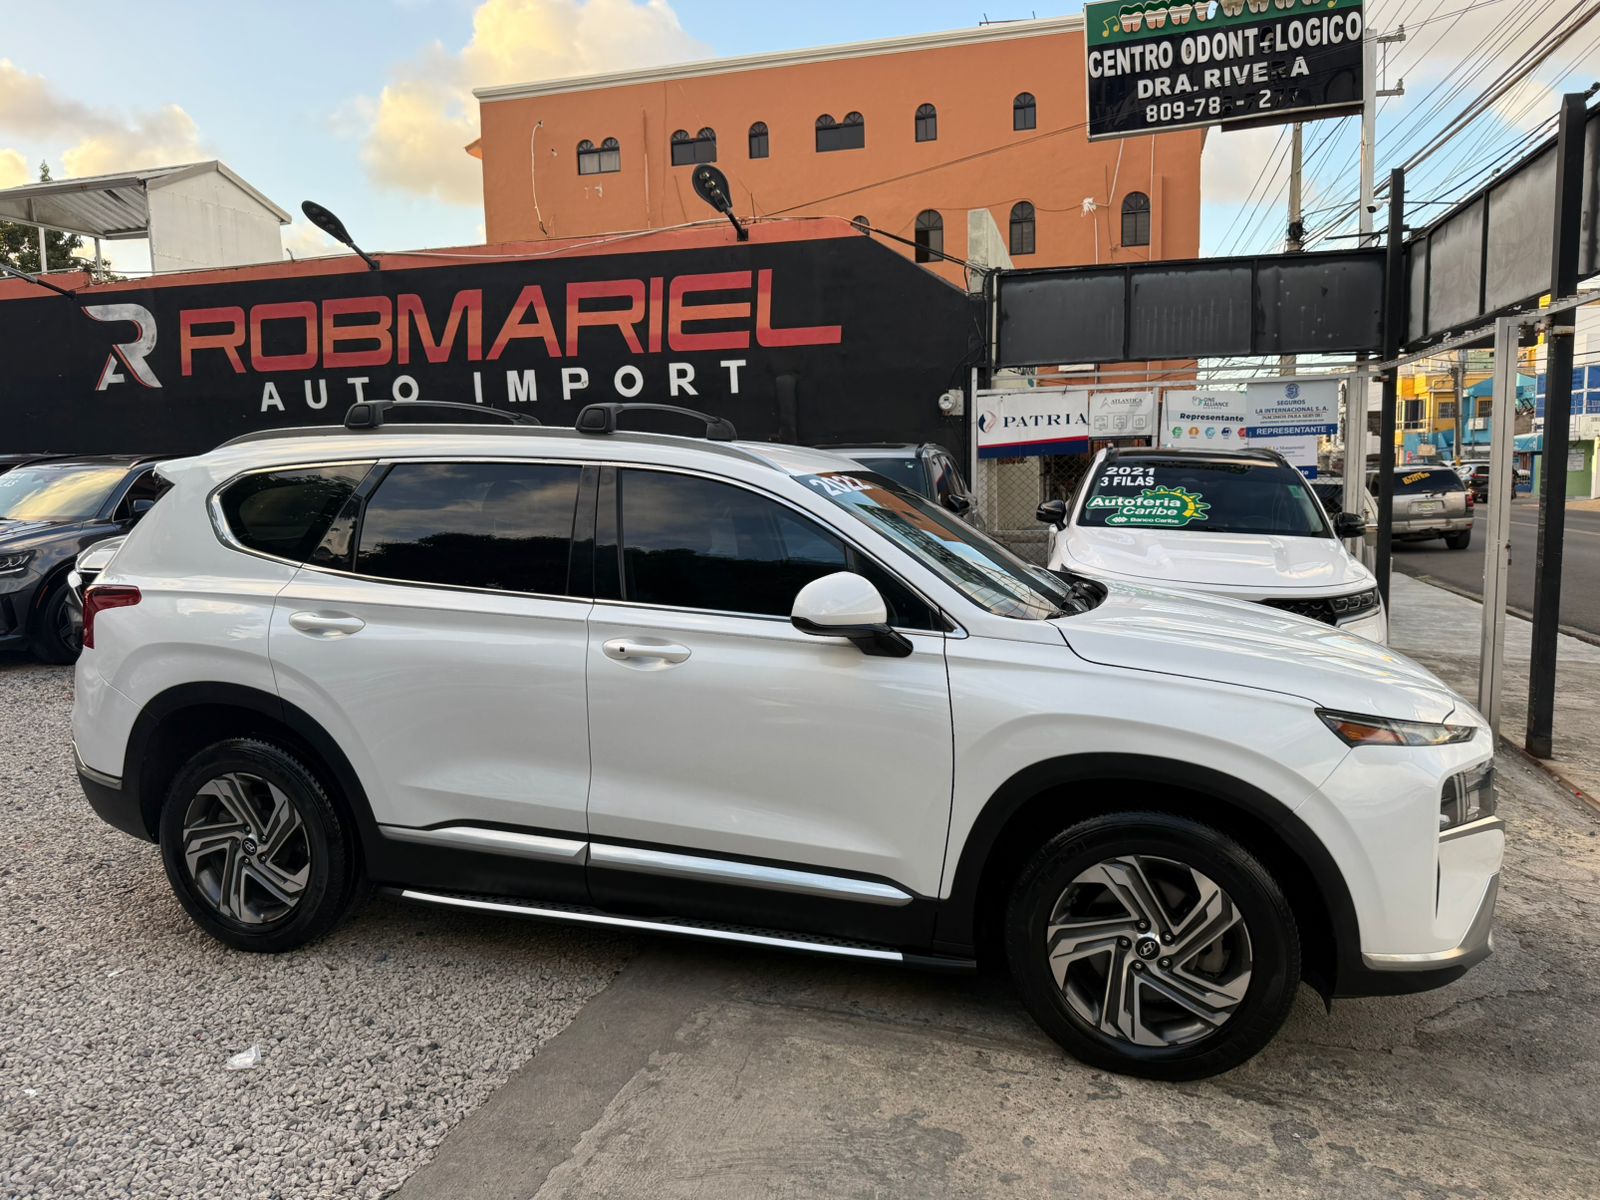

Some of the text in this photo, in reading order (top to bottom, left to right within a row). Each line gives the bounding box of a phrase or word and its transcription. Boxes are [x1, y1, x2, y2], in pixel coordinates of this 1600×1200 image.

[1089, 41, 1173, 79] CENTRO
[1138, 56, 1310, 99] DRA. RIVEA
[179, 268, 842, 377] ROBMARIEL
[260, 359, 747, 412] AUTO IMPORT
[1264, 405, 1314, 414] INTERNACIONAL
[1003, 413, 1091, 428] PATRIA
[1180, 412, 1245, 422] Representante
[1256, 425, 1327, 435] REPRESENTANTE
[1105, 466, 1155, 476] 2021
[1100, 476, 1155, 486] 3 FILAS
[1090, 497, 1181, 507] Autoferia
[1123, 506, 1178, 515] Caribe
